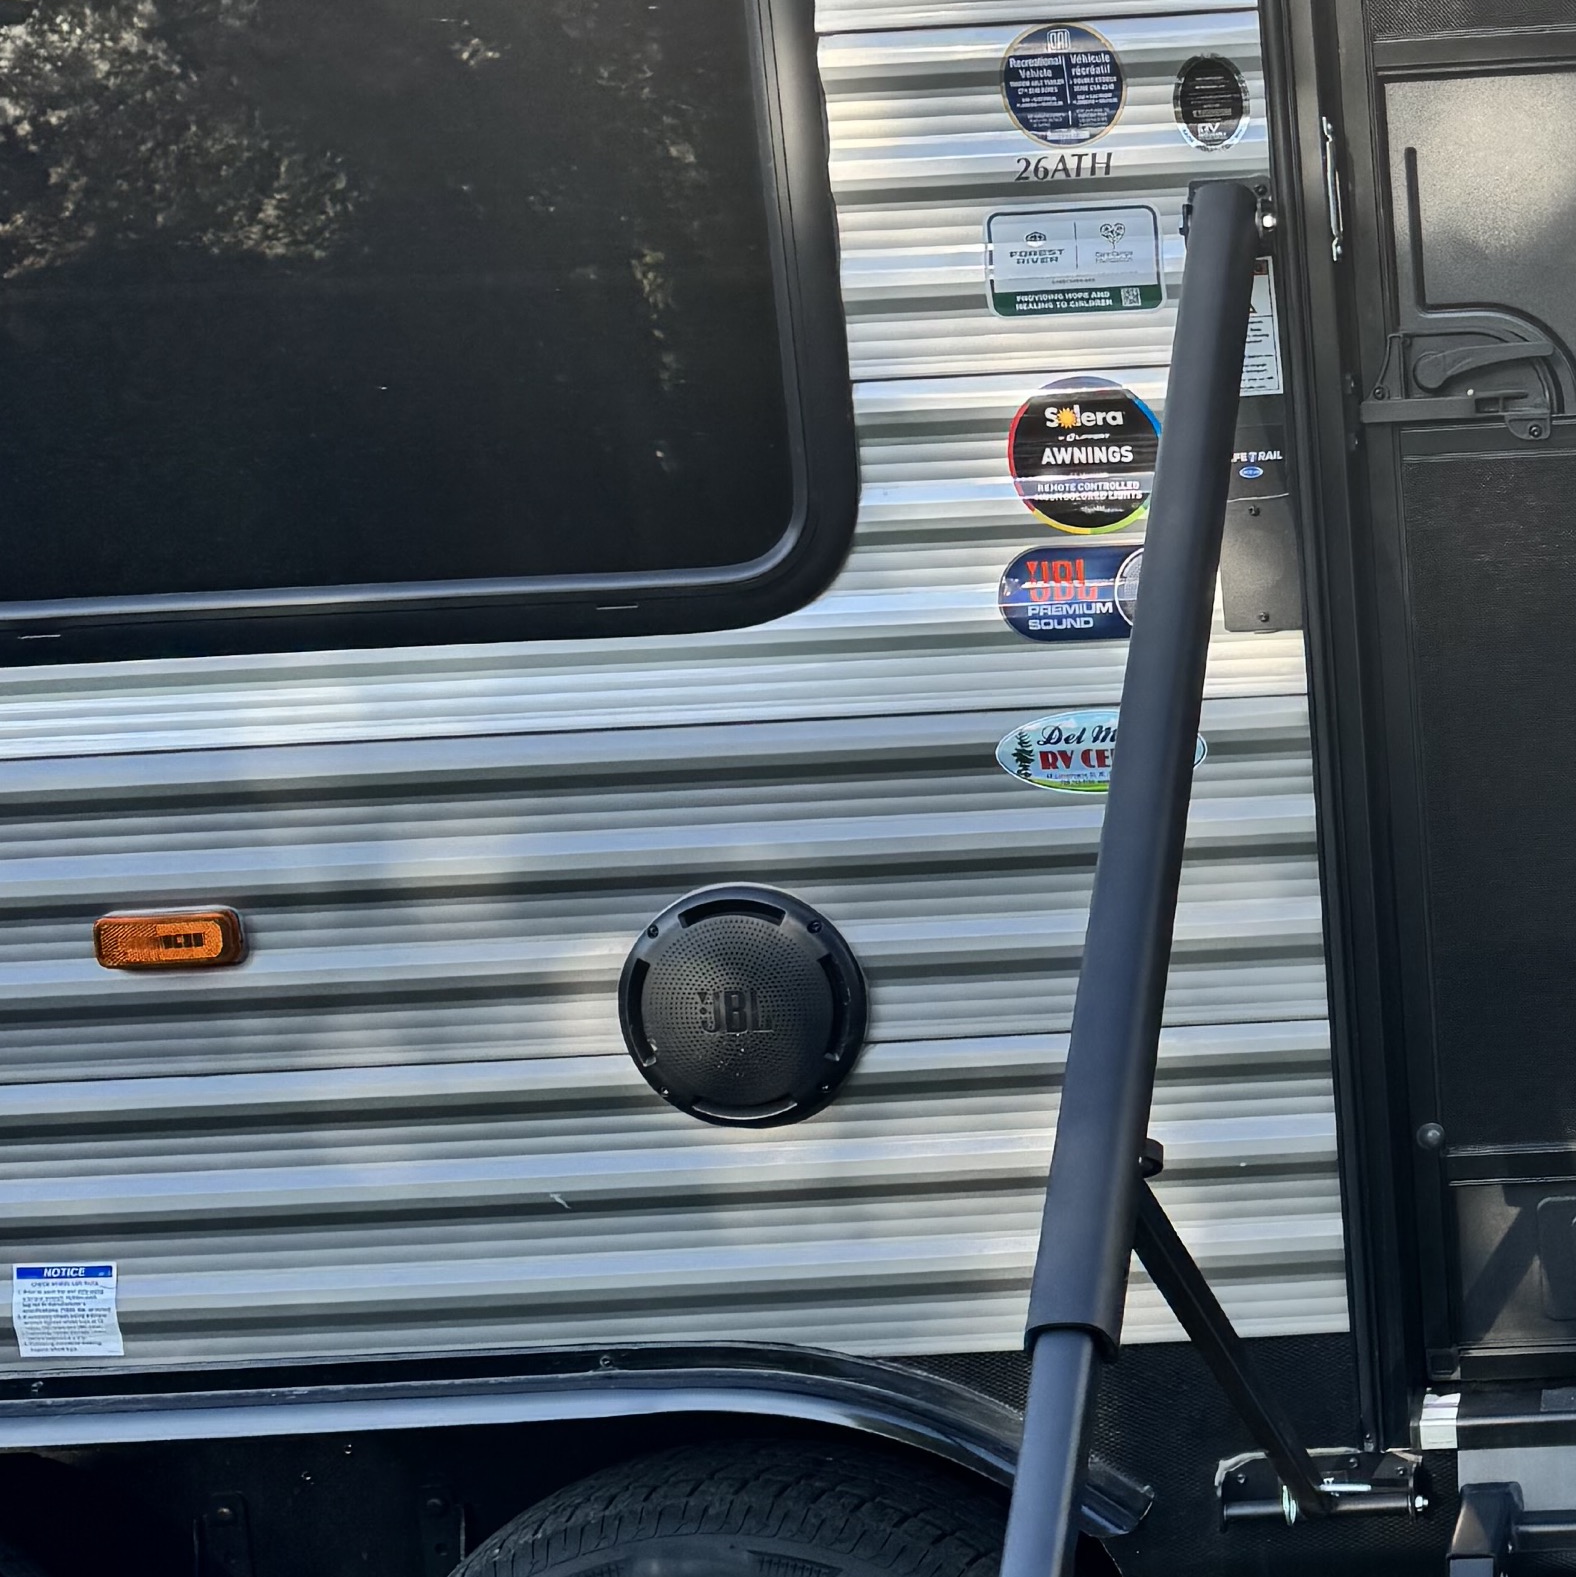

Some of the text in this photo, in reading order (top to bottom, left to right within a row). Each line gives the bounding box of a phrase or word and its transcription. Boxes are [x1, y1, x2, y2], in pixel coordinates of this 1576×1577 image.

[1009, 56, 1062, 68] Recreational
[1019, 68, 1053, 78] Vehicle
[1014, 152, 1113, 182] 26ATH
[1009, 248, 1065, 258] FOREST
[1016, 256, 1059, 265] RIVER
[1091, 291, 1111, 299] AND
[1056, 301, 1067, 309] TO
[1041, 445, 1134, 465] AWNINGS
[1037, 480, 1140, 492] REMOTE CONTROLLED
[1025, 558, 1098, 602] JBL
[1027, 602, 1114, 617] PREMIUM
[1028, 617, 1094, 630] SOUND
[1037, 724, 1116, 746] Del M
[1039, 750, 1074, 771] RV
[697, 990, 774, 1034] JBL
[43, 1267, 86, 1278] NOTICE
